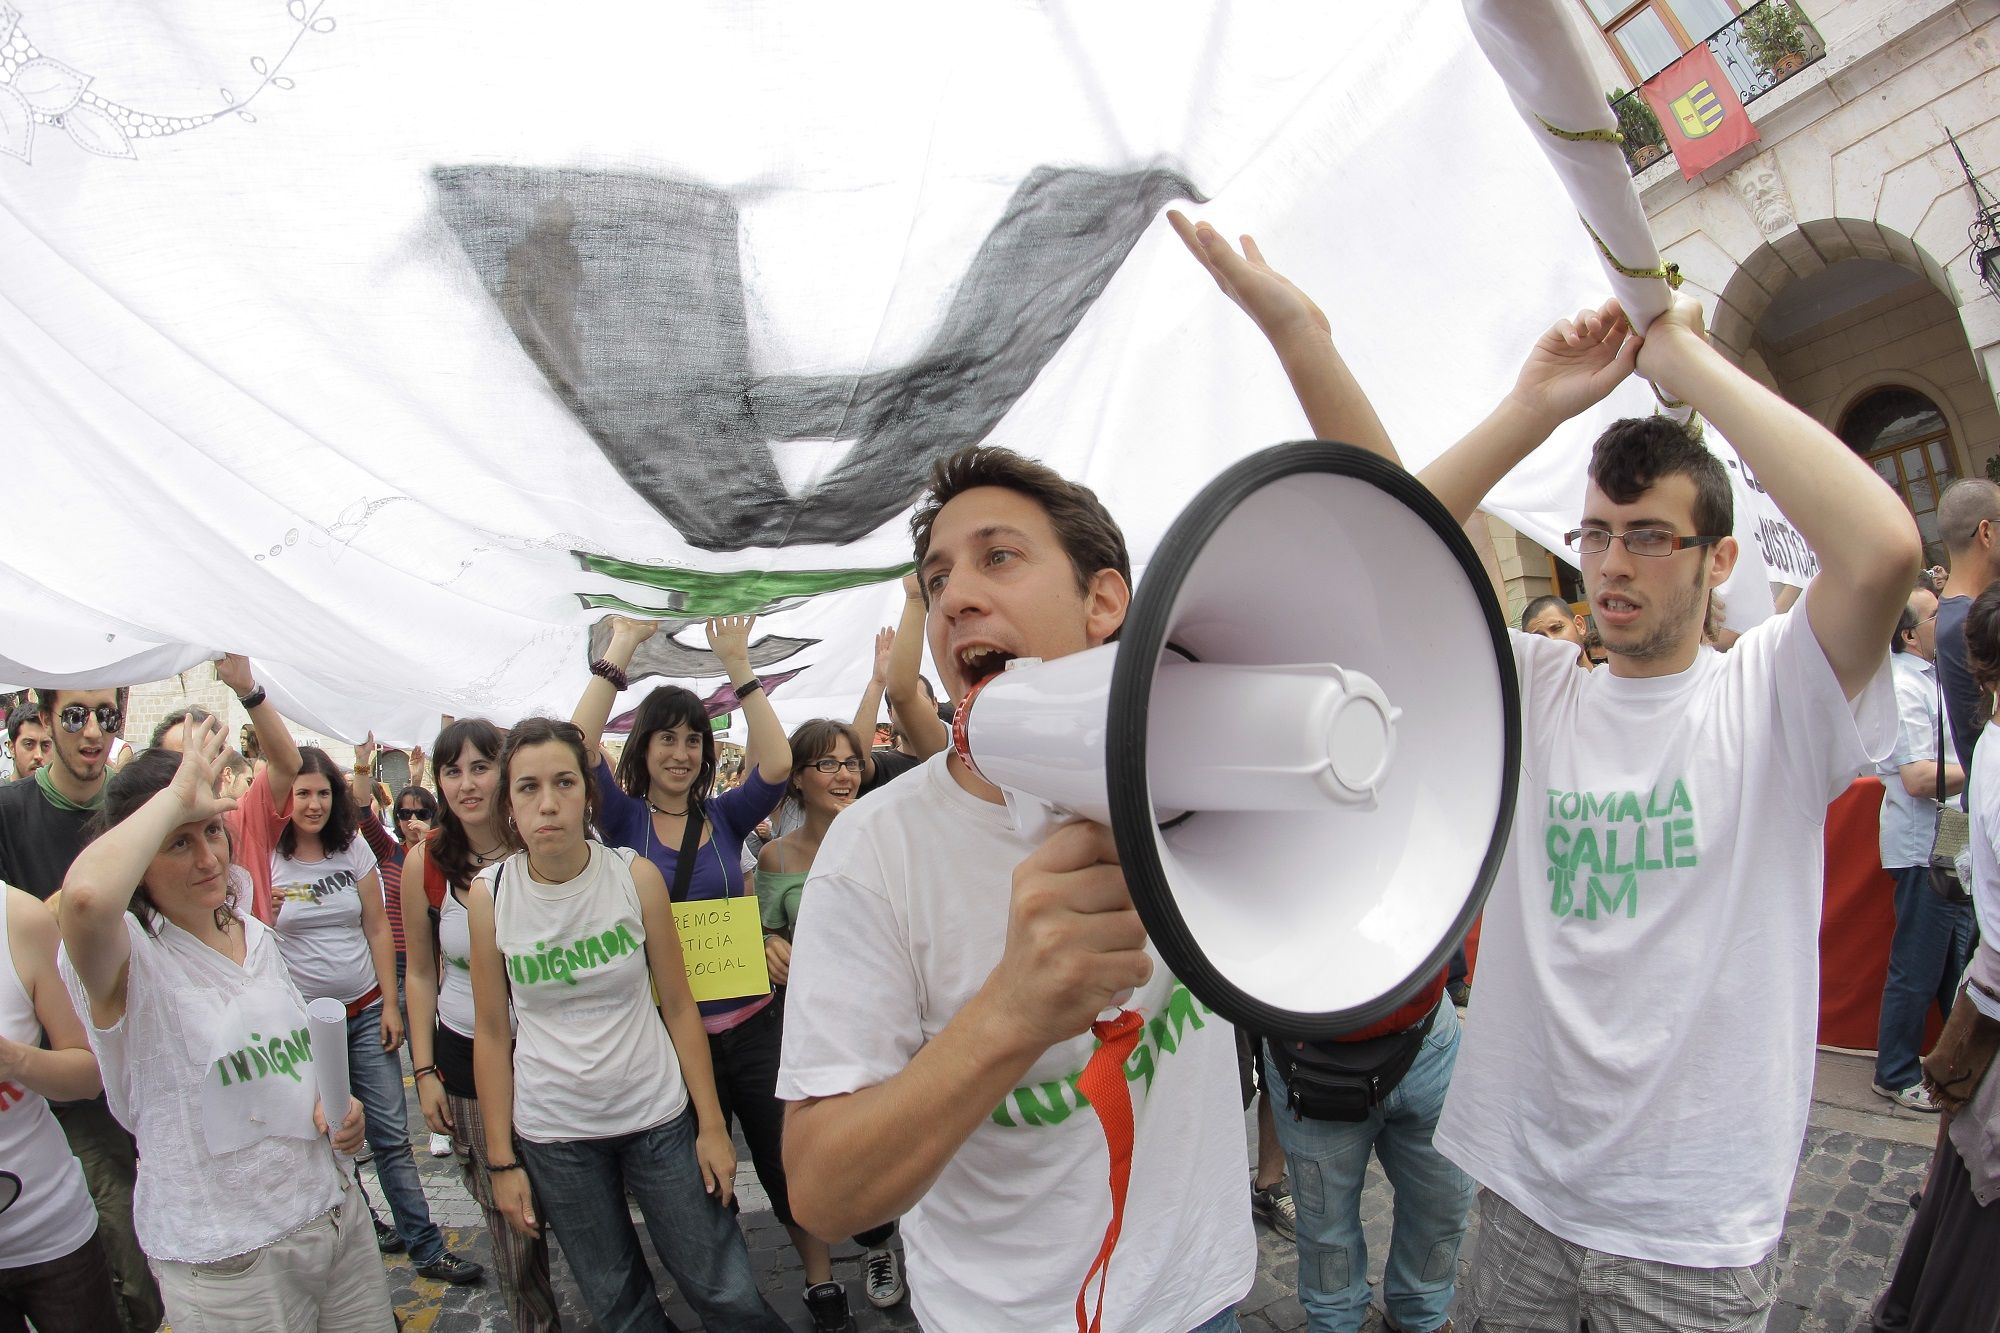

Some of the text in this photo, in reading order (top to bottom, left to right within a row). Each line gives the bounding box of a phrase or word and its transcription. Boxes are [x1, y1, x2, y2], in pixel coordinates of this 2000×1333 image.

[1546, 820, 1697, 873] CALLE
[673, 911, 731, 930] REMOS
[680, 933, 733, 952] TICIA
